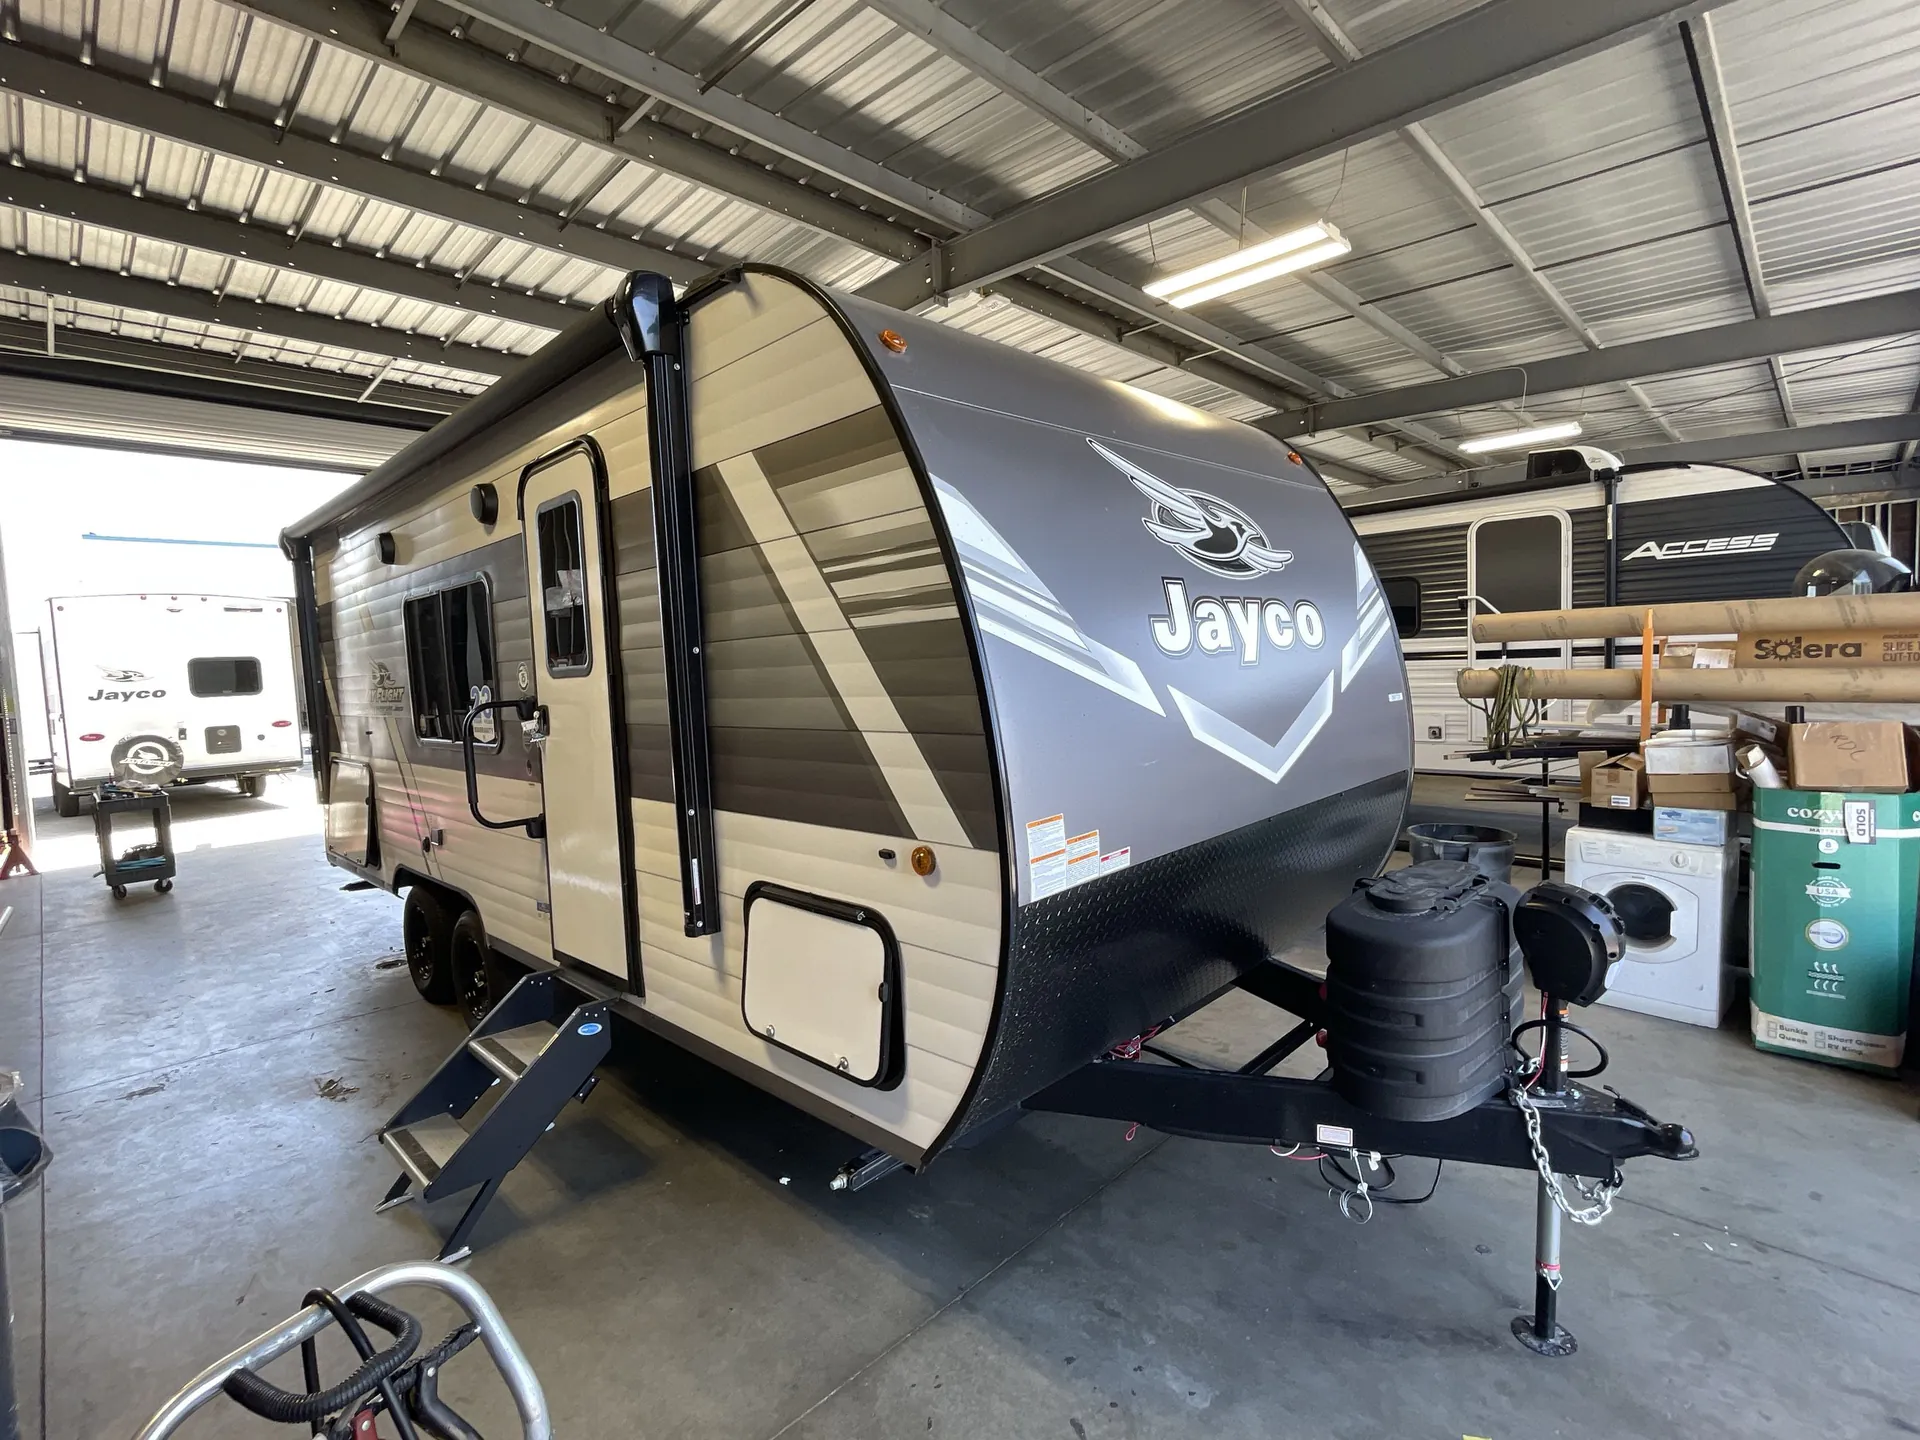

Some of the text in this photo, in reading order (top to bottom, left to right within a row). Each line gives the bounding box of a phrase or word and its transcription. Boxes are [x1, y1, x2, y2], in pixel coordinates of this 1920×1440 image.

[1622, 533, 1780, 561] ACCESS
[1148, 576, 1326, 667] Jayco
[1754, 636, 1862, 662] Solera
[1883, 641, 1913, 651] SLIDE
[87, 689, 167, 703] Jayco
[1856, 808, 1866, 837] SOLD
[1816, 887, 1839, 895] USA
[1827, 1034, 1853, 1044] Short
[1827, 1043, 1840, 1051] RV
